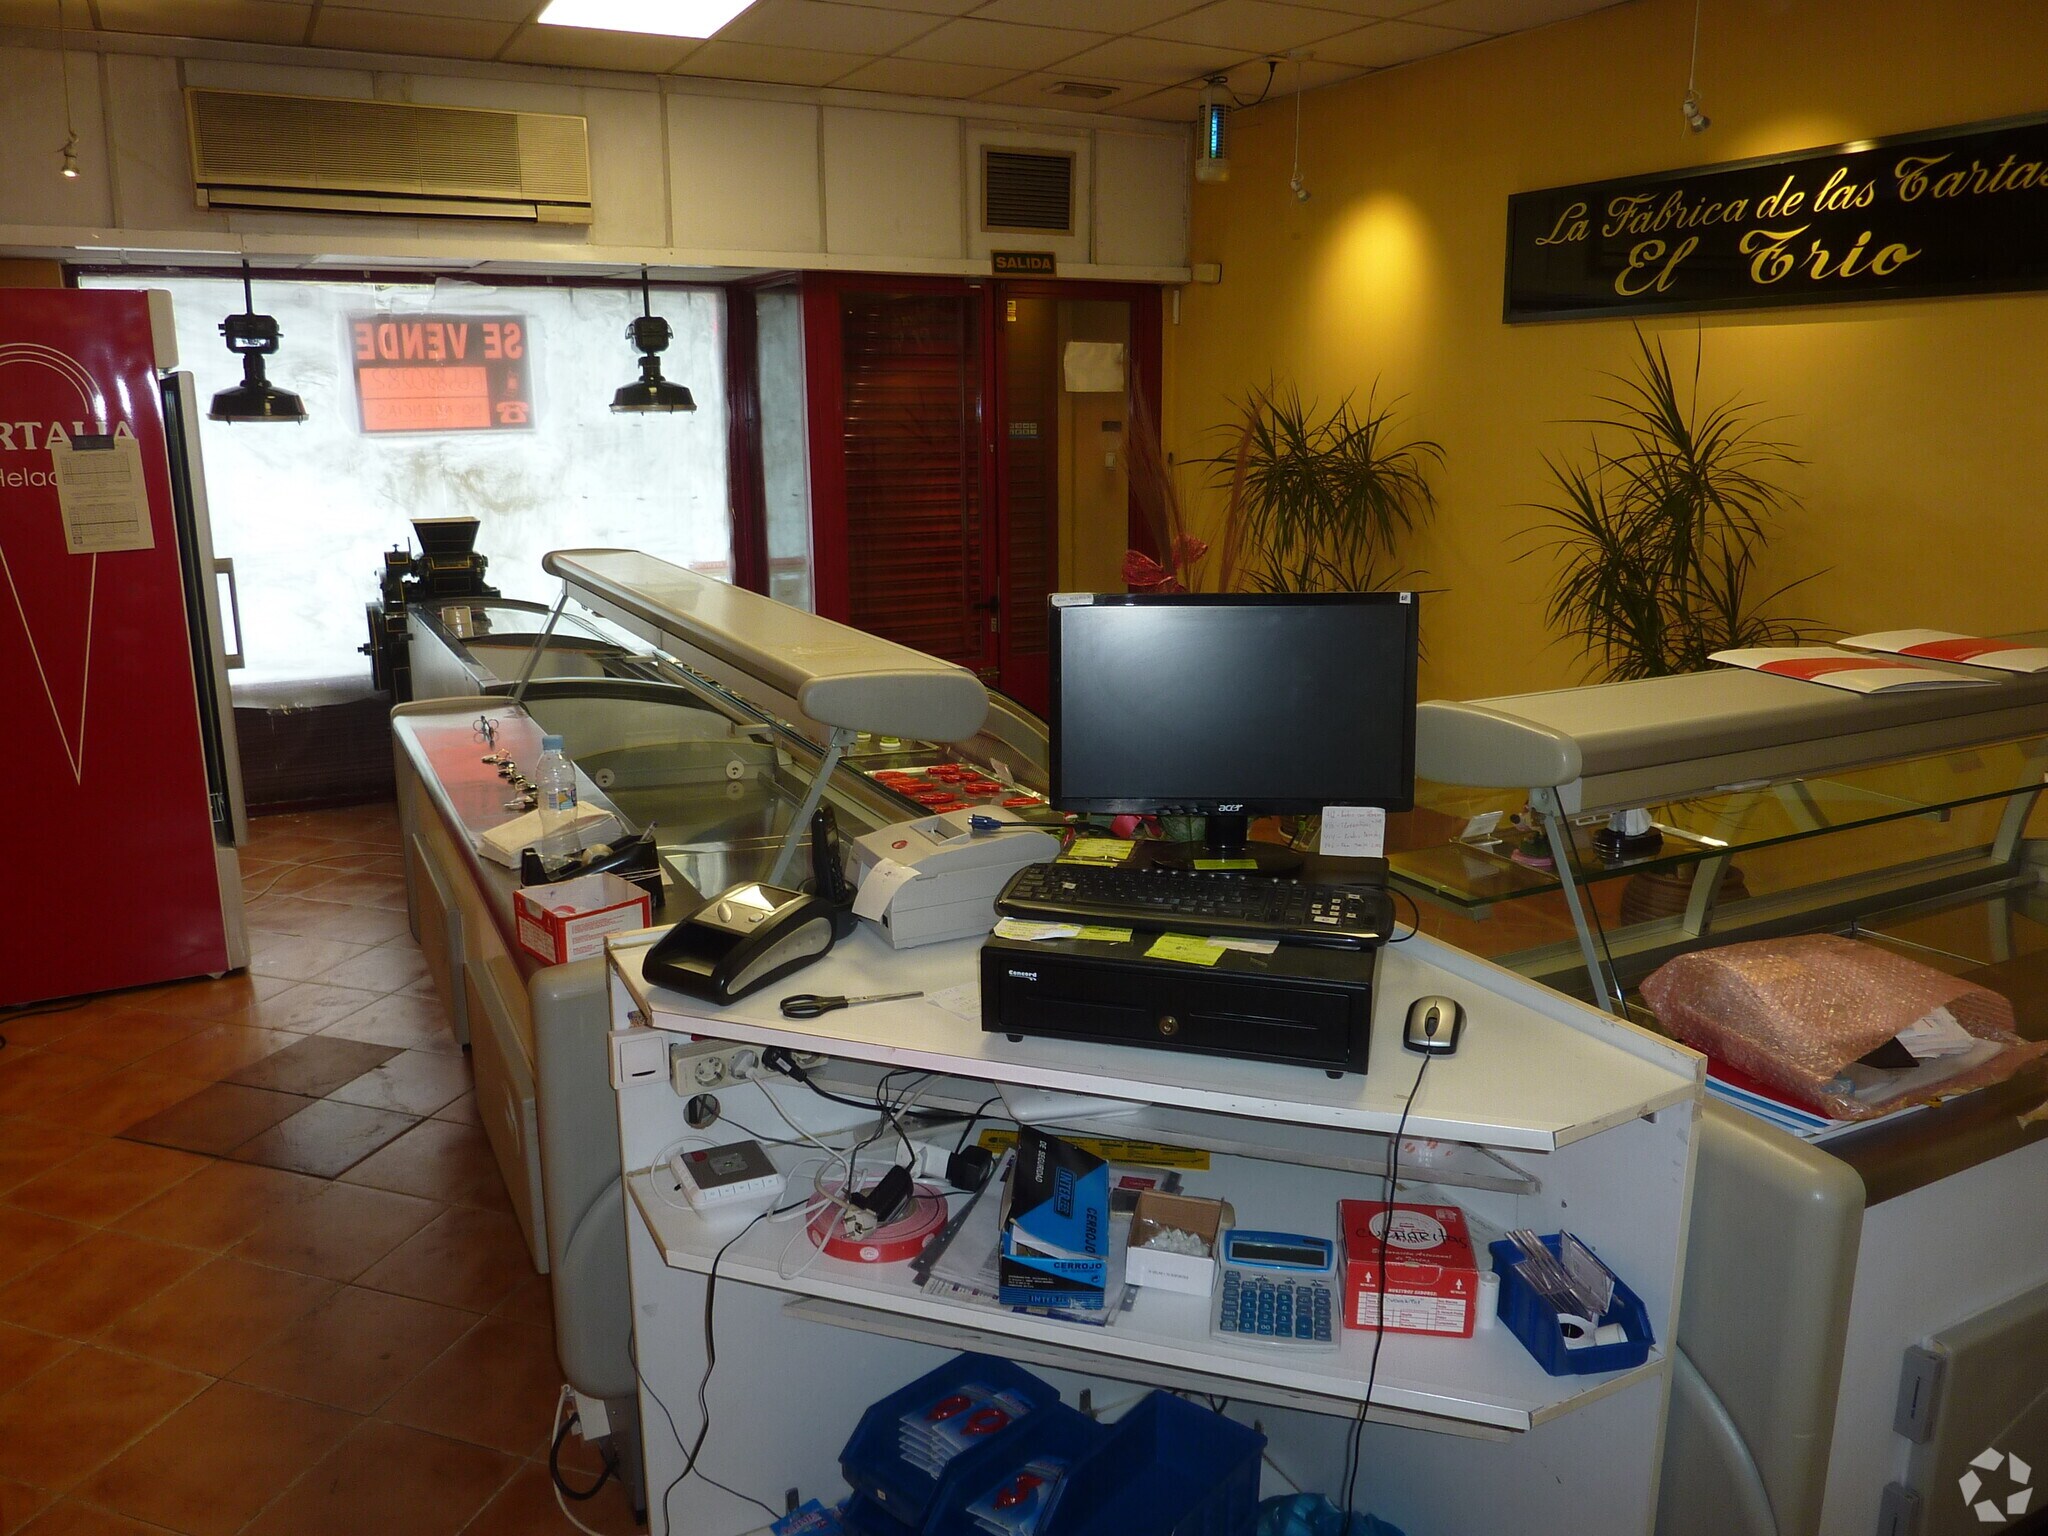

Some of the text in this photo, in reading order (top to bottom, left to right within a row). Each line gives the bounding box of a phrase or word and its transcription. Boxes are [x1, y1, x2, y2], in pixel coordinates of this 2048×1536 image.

[1535, 202, 1590, 246] La
[1756, 175, 1805, 219] de
[1813, 167, 1877, 212] las
[996, 256, 1053, 269] SALIDA
[1615, 223, 1922, 296] El Trio
[1218, 804, 1243, 812] acer
[1008, 969, 1037, 978] Concord
[1035, 1140, 1047, 1183] DE SEGURIDAD
[1084, 1207, 1098, 1253] CERROJO
[1053, 1262, 1102, 1270] CERROJO
